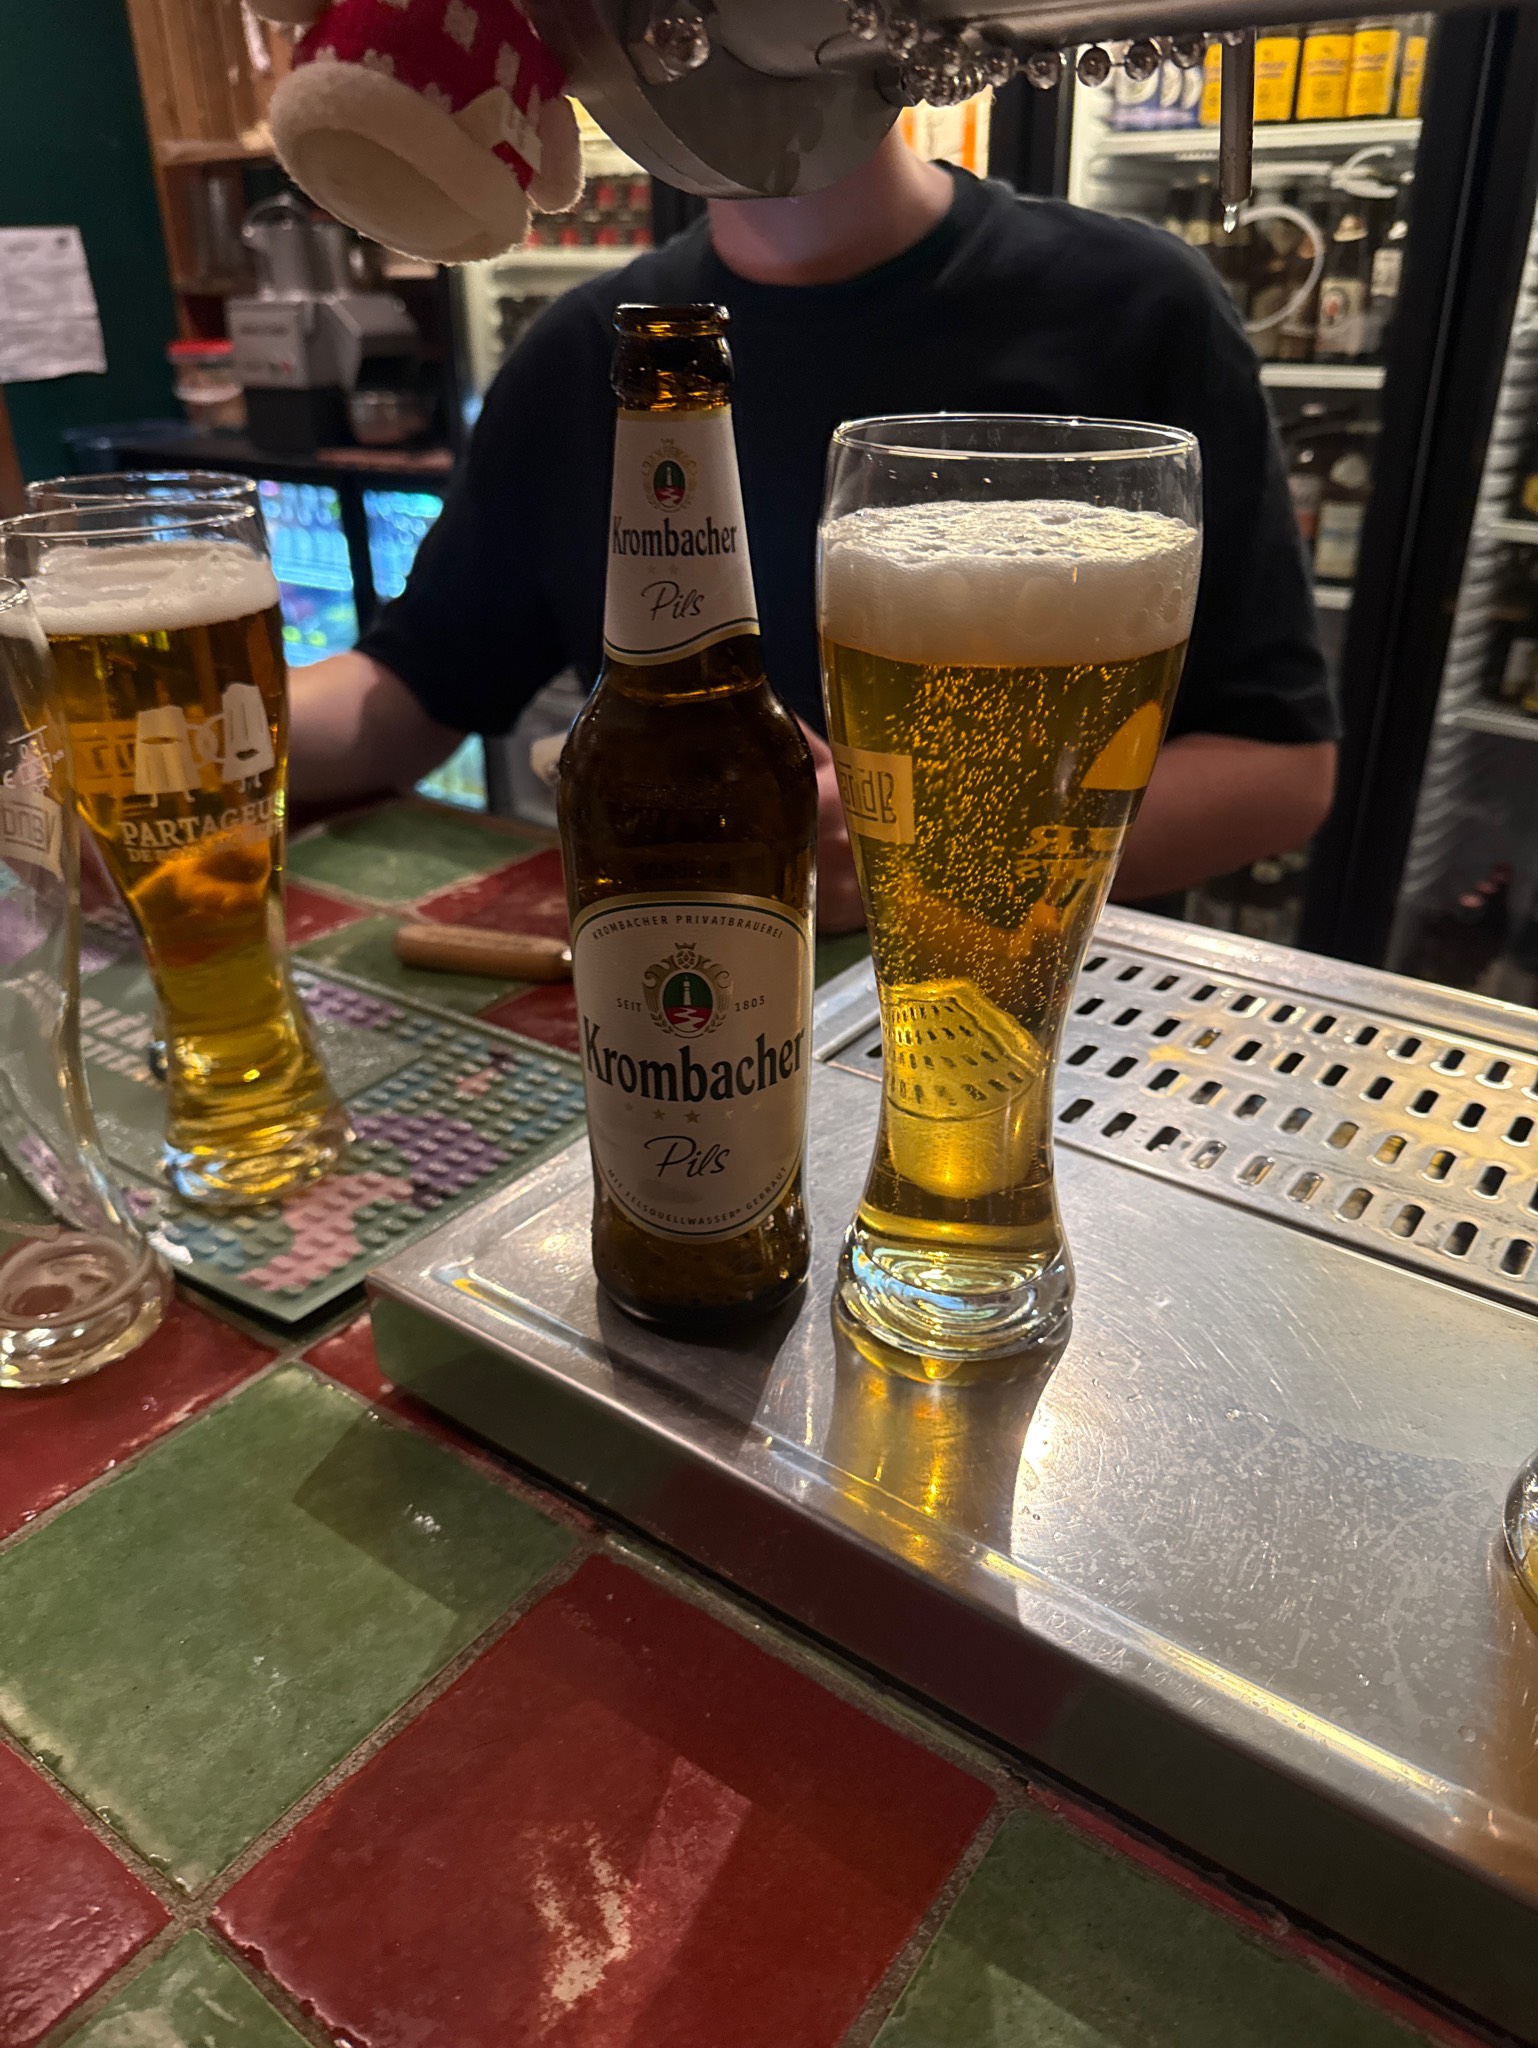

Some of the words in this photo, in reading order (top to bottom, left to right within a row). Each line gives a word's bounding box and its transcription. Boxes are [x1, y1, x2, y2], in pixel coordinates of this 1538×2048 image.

[612, 515, 737, 557] Krombacher
[640, 580, 705, 622] Pils
[118, 793, 281, 848] PARTAGEU
[592, 914, 669, 941] KROMBACHER
[676, 914, 784, 940] PRIVATBRAUEREI
[616, 997, 643, 1013] SEIT
[734, 995, 766, 1013] 1803
[582, 1014, 806, 1103] Krombacher
[643, 1134, 732, 1179] Pils
[607, 1169, 624, 1190] MIT
[745, 1166, 788, 1211] GEBRAUT
